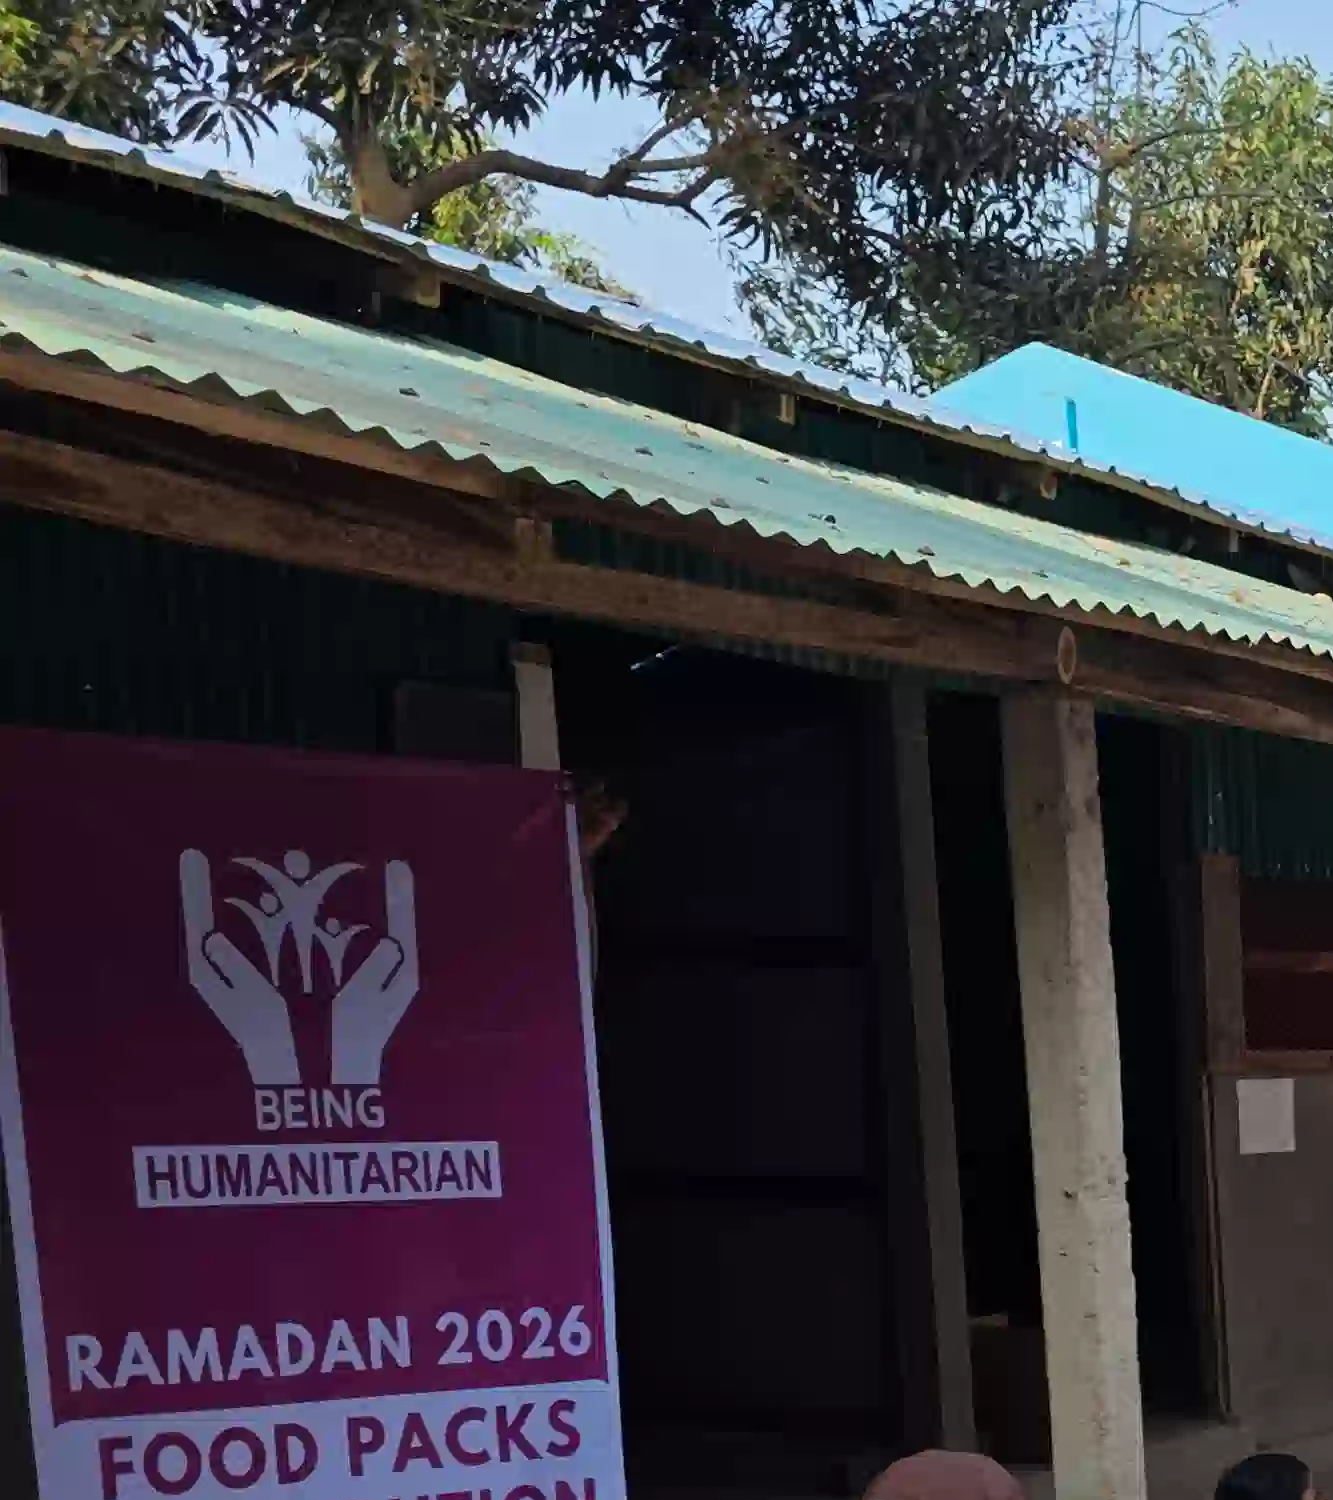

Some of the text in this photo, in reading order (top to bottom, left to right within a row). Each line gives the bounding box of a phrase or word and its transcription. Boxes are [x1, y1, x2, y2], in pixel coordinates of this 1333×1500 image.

[254, 1088, 385, 1131] BEING
[146, 1149, 493, 1199] HUMANITARIAN
[65, 1304, 592, 1392] RAMADAN 2026
[99, 1399, 582, 1500] FOOD PACKS
